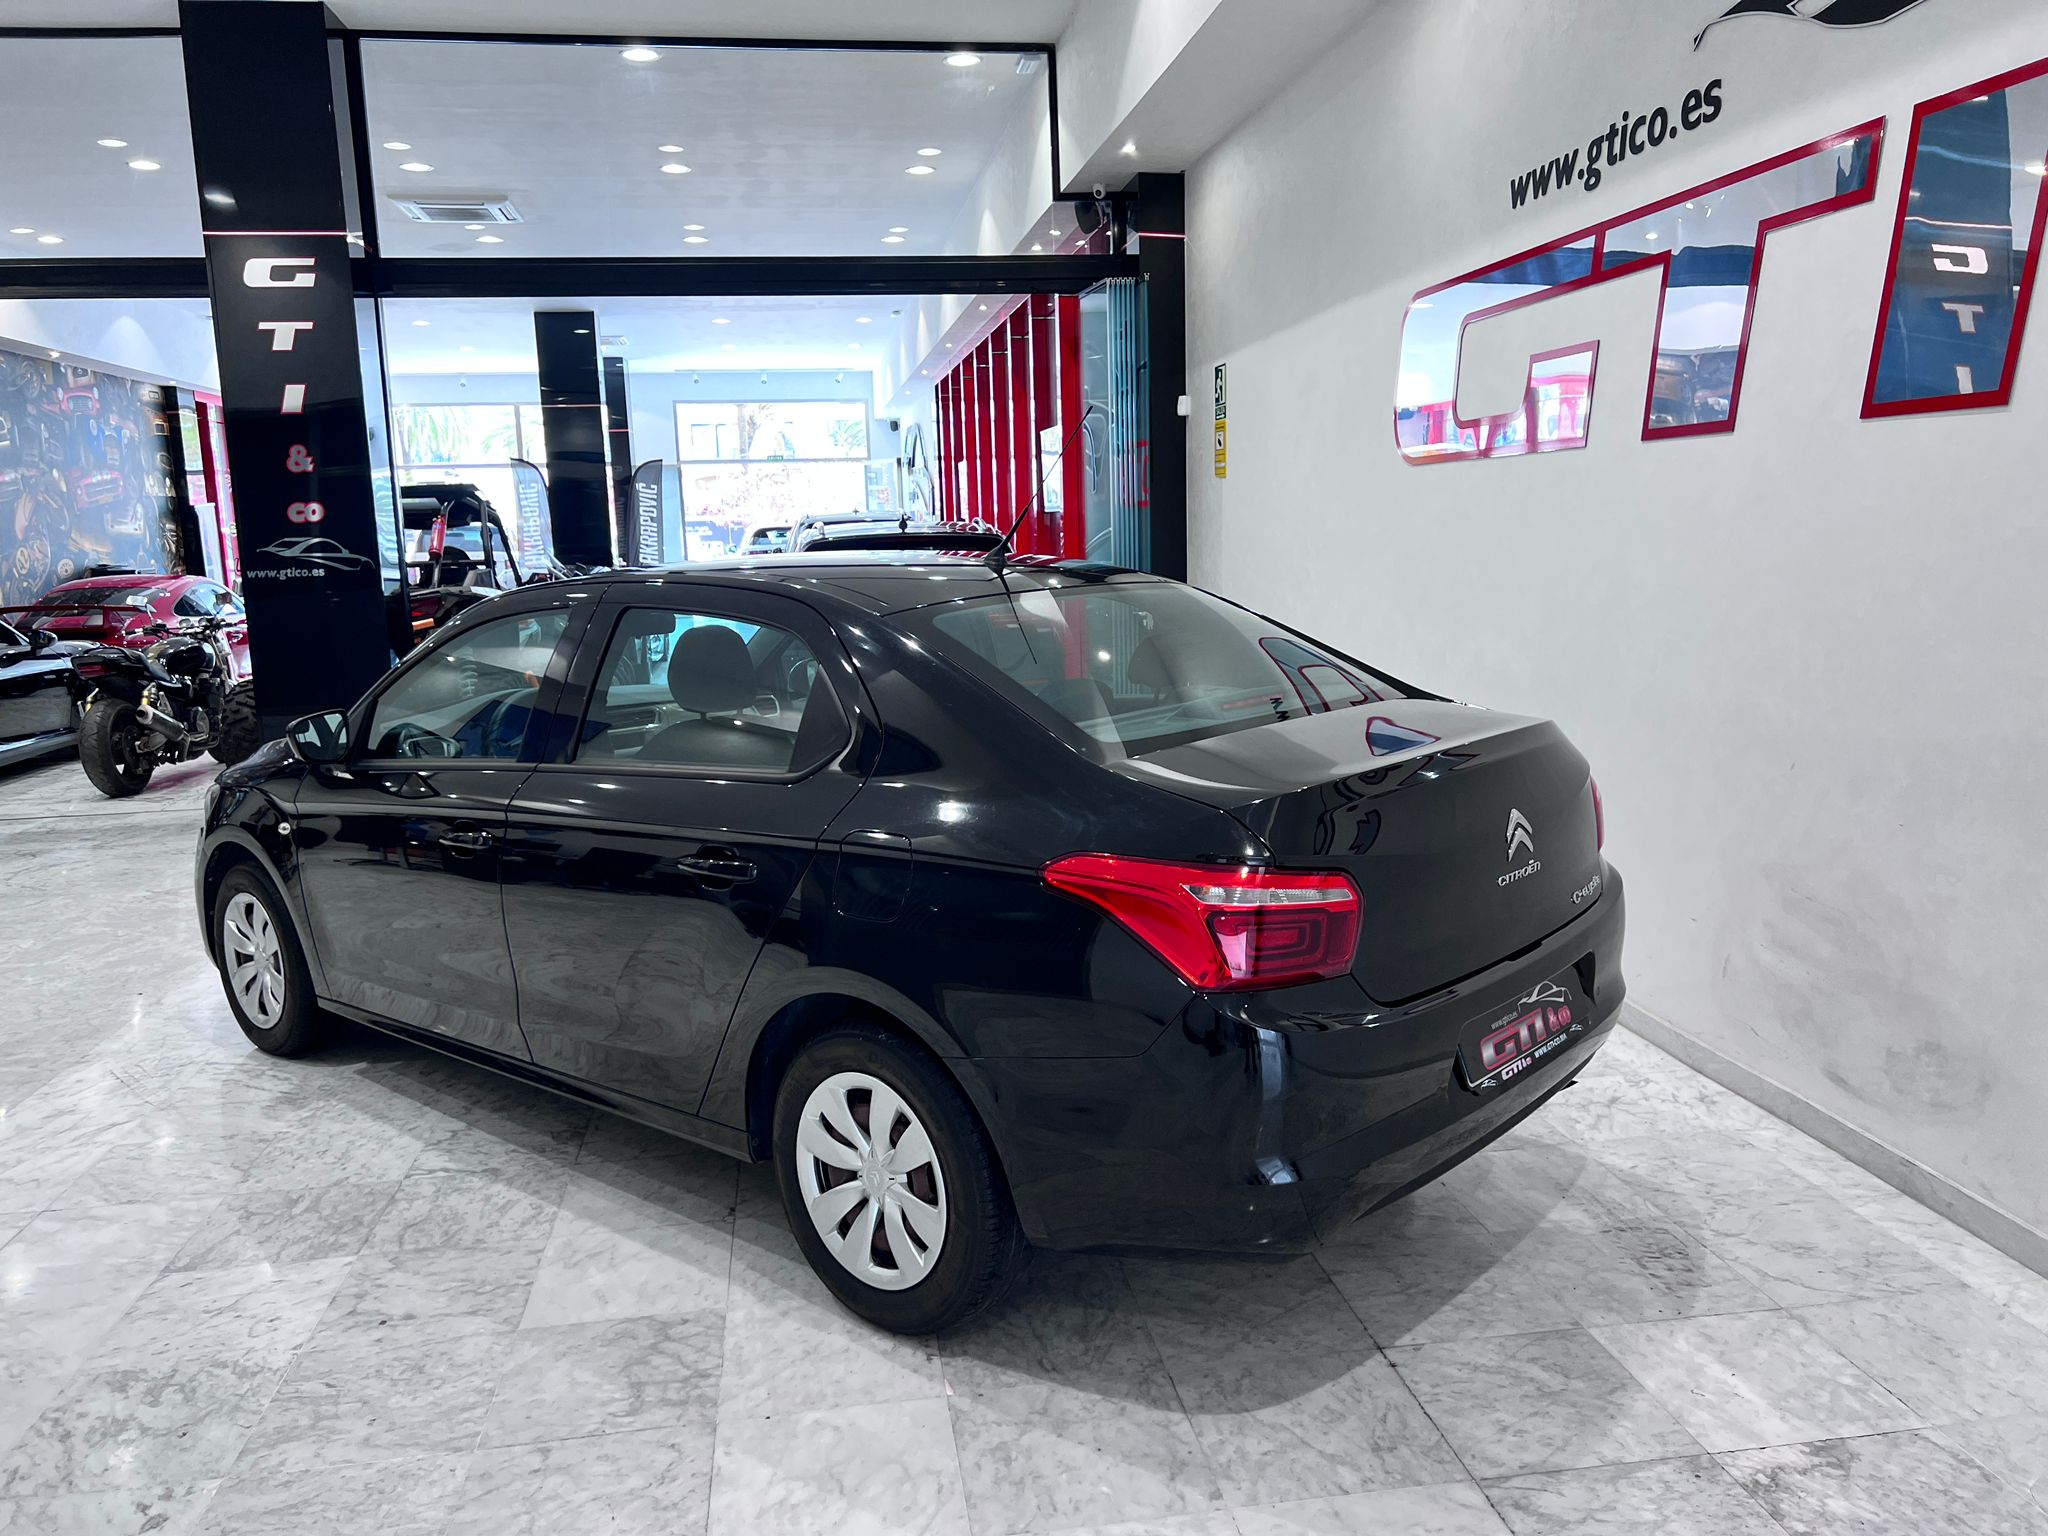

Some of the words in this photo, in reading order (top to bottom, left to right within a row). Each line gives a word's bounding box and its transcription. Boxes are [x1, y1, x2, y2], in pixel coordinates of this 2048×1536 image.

[1510, 78, 1722, 209] www.gtico.es
[1394, 57, 2048, 466] GTI
[247, 566, 325, 581] www.gtico.es
[1498, 859, 1541, 887] CITROËN
[1480, 1007, 1547, 1071] GTI
